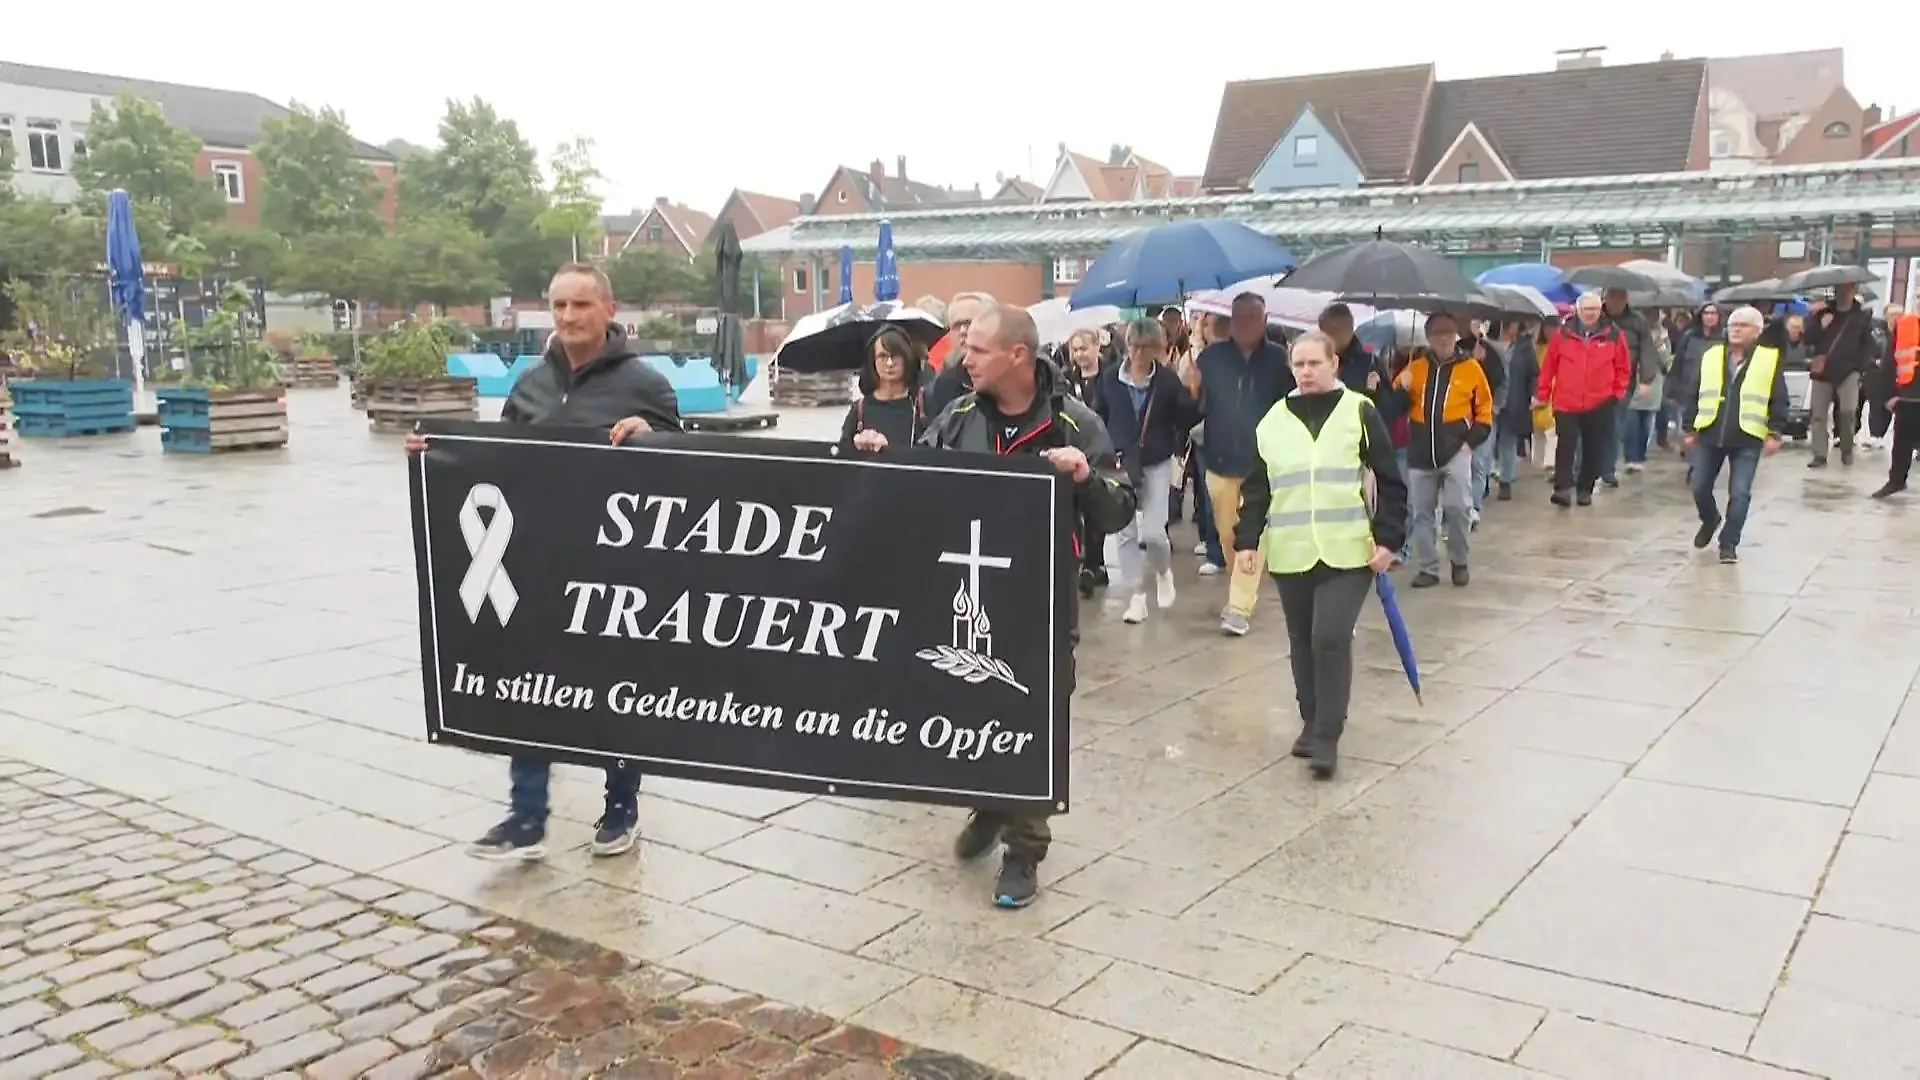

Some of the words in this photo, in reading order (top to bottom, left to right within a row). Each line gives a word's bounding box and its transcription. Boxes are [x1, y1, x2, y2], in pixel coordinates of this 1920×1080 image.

[597, 492, 833, 562] STADE
[563, 582, 901, 663] TRAUERT
[452, 662, 485, 697] In
[496, 672, 594, 710] stillen
[608, 682, 783, 731] Gedenken
[796, 709, 840, 738] an
[852, 708, 908, 746] die
[920, 716, 1034, 760] Opfer
